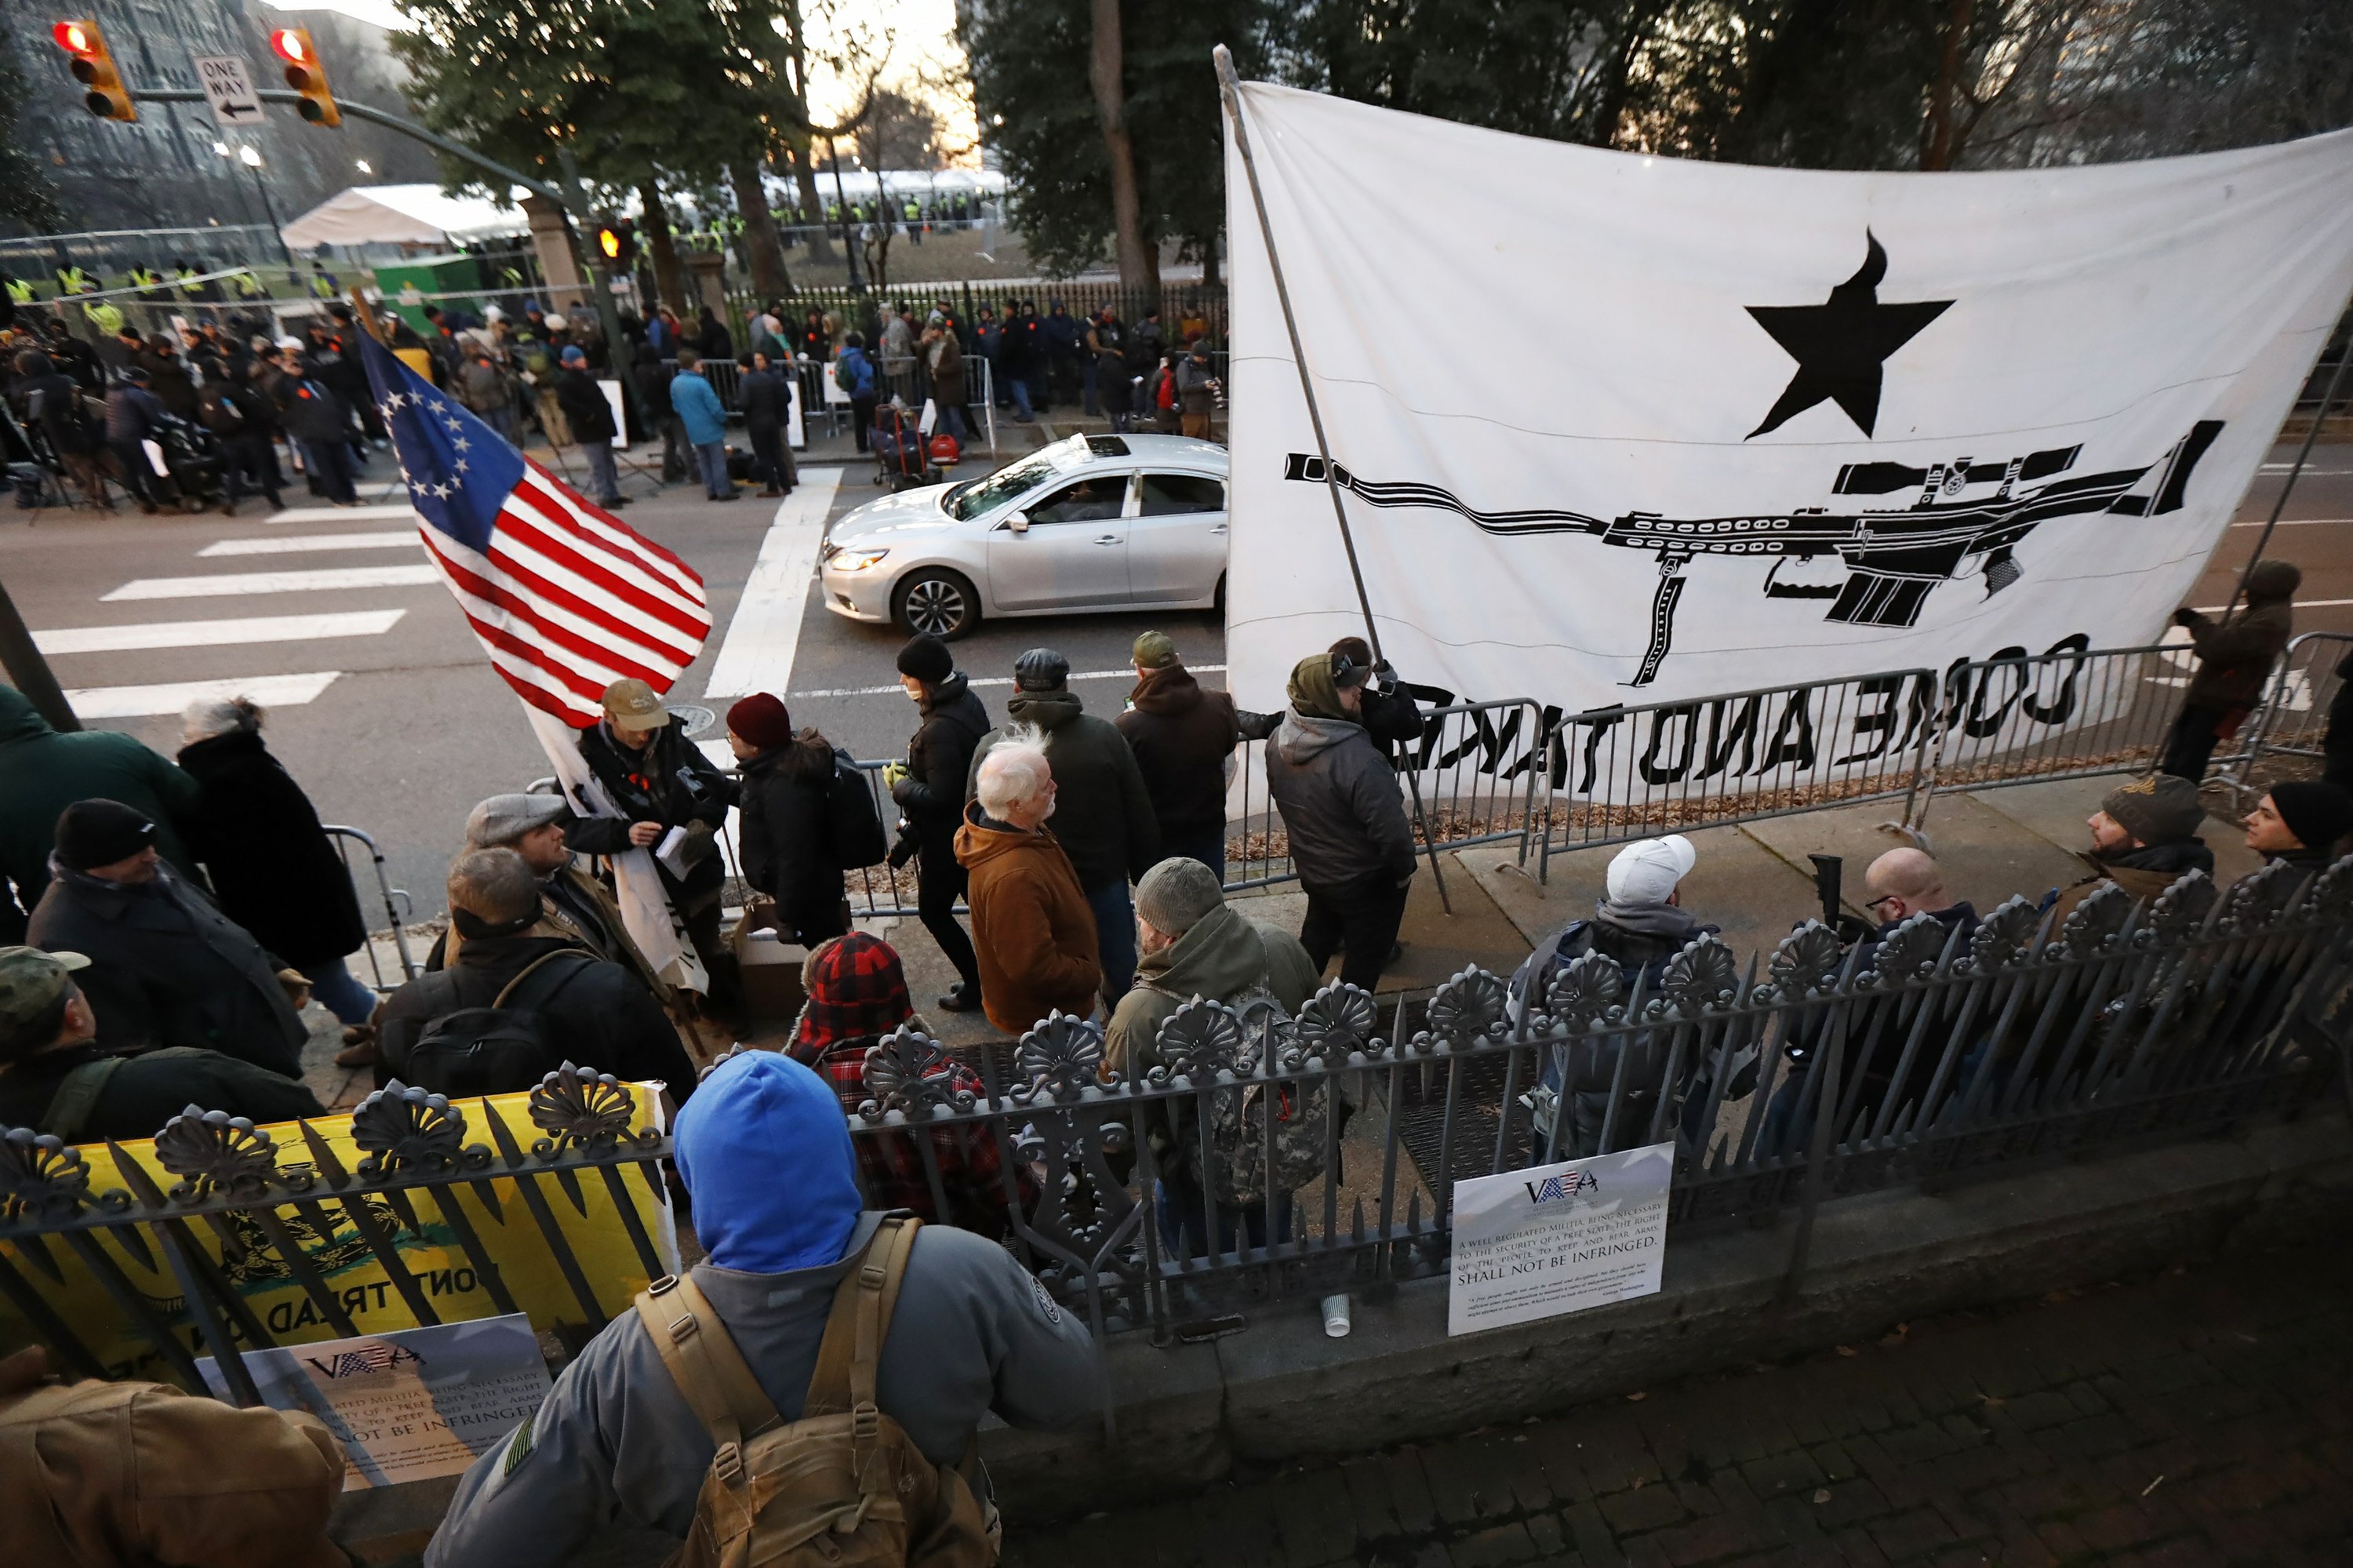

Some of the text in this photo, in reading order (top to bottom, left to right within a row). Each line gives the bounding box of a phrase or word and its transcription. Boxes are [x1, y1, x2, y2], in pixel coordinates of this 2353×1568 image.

[204, 60, 238, 78] ONE
[209, 80, 246, 96] WAY
[1469, 1238, 1492, 1247] WELL
[1496, 1227, 1545, 1242] REGULATED
[1588, 1212, 1614, 1224] BEING
[1617, 1204, 1660, 1218] NECESSARY
[1496, 1240, 1537, 1253] SECURITY
[1563, 1230, 1583, 1239] FREE
[1616, 1220, 1631, 1228] THE
[1635, 1213, 1659, 1224] RIGHT
[1458, 1263, 1469, 1271] OF
[1477, 1259, 1493, 1268] THE
[1502, 1251, 1533, 1262] PEOPLE
[1558, 1242, 1577, 1251] KEEP
[1584, 1237, 1602, 1246] AND
[1609, 1231, 1629, 1240] BEAR
[1459, 1237, 1656, 1286] SHALL NOT BE INFRINGED.
[391, 1424, 415, 1436] BE
